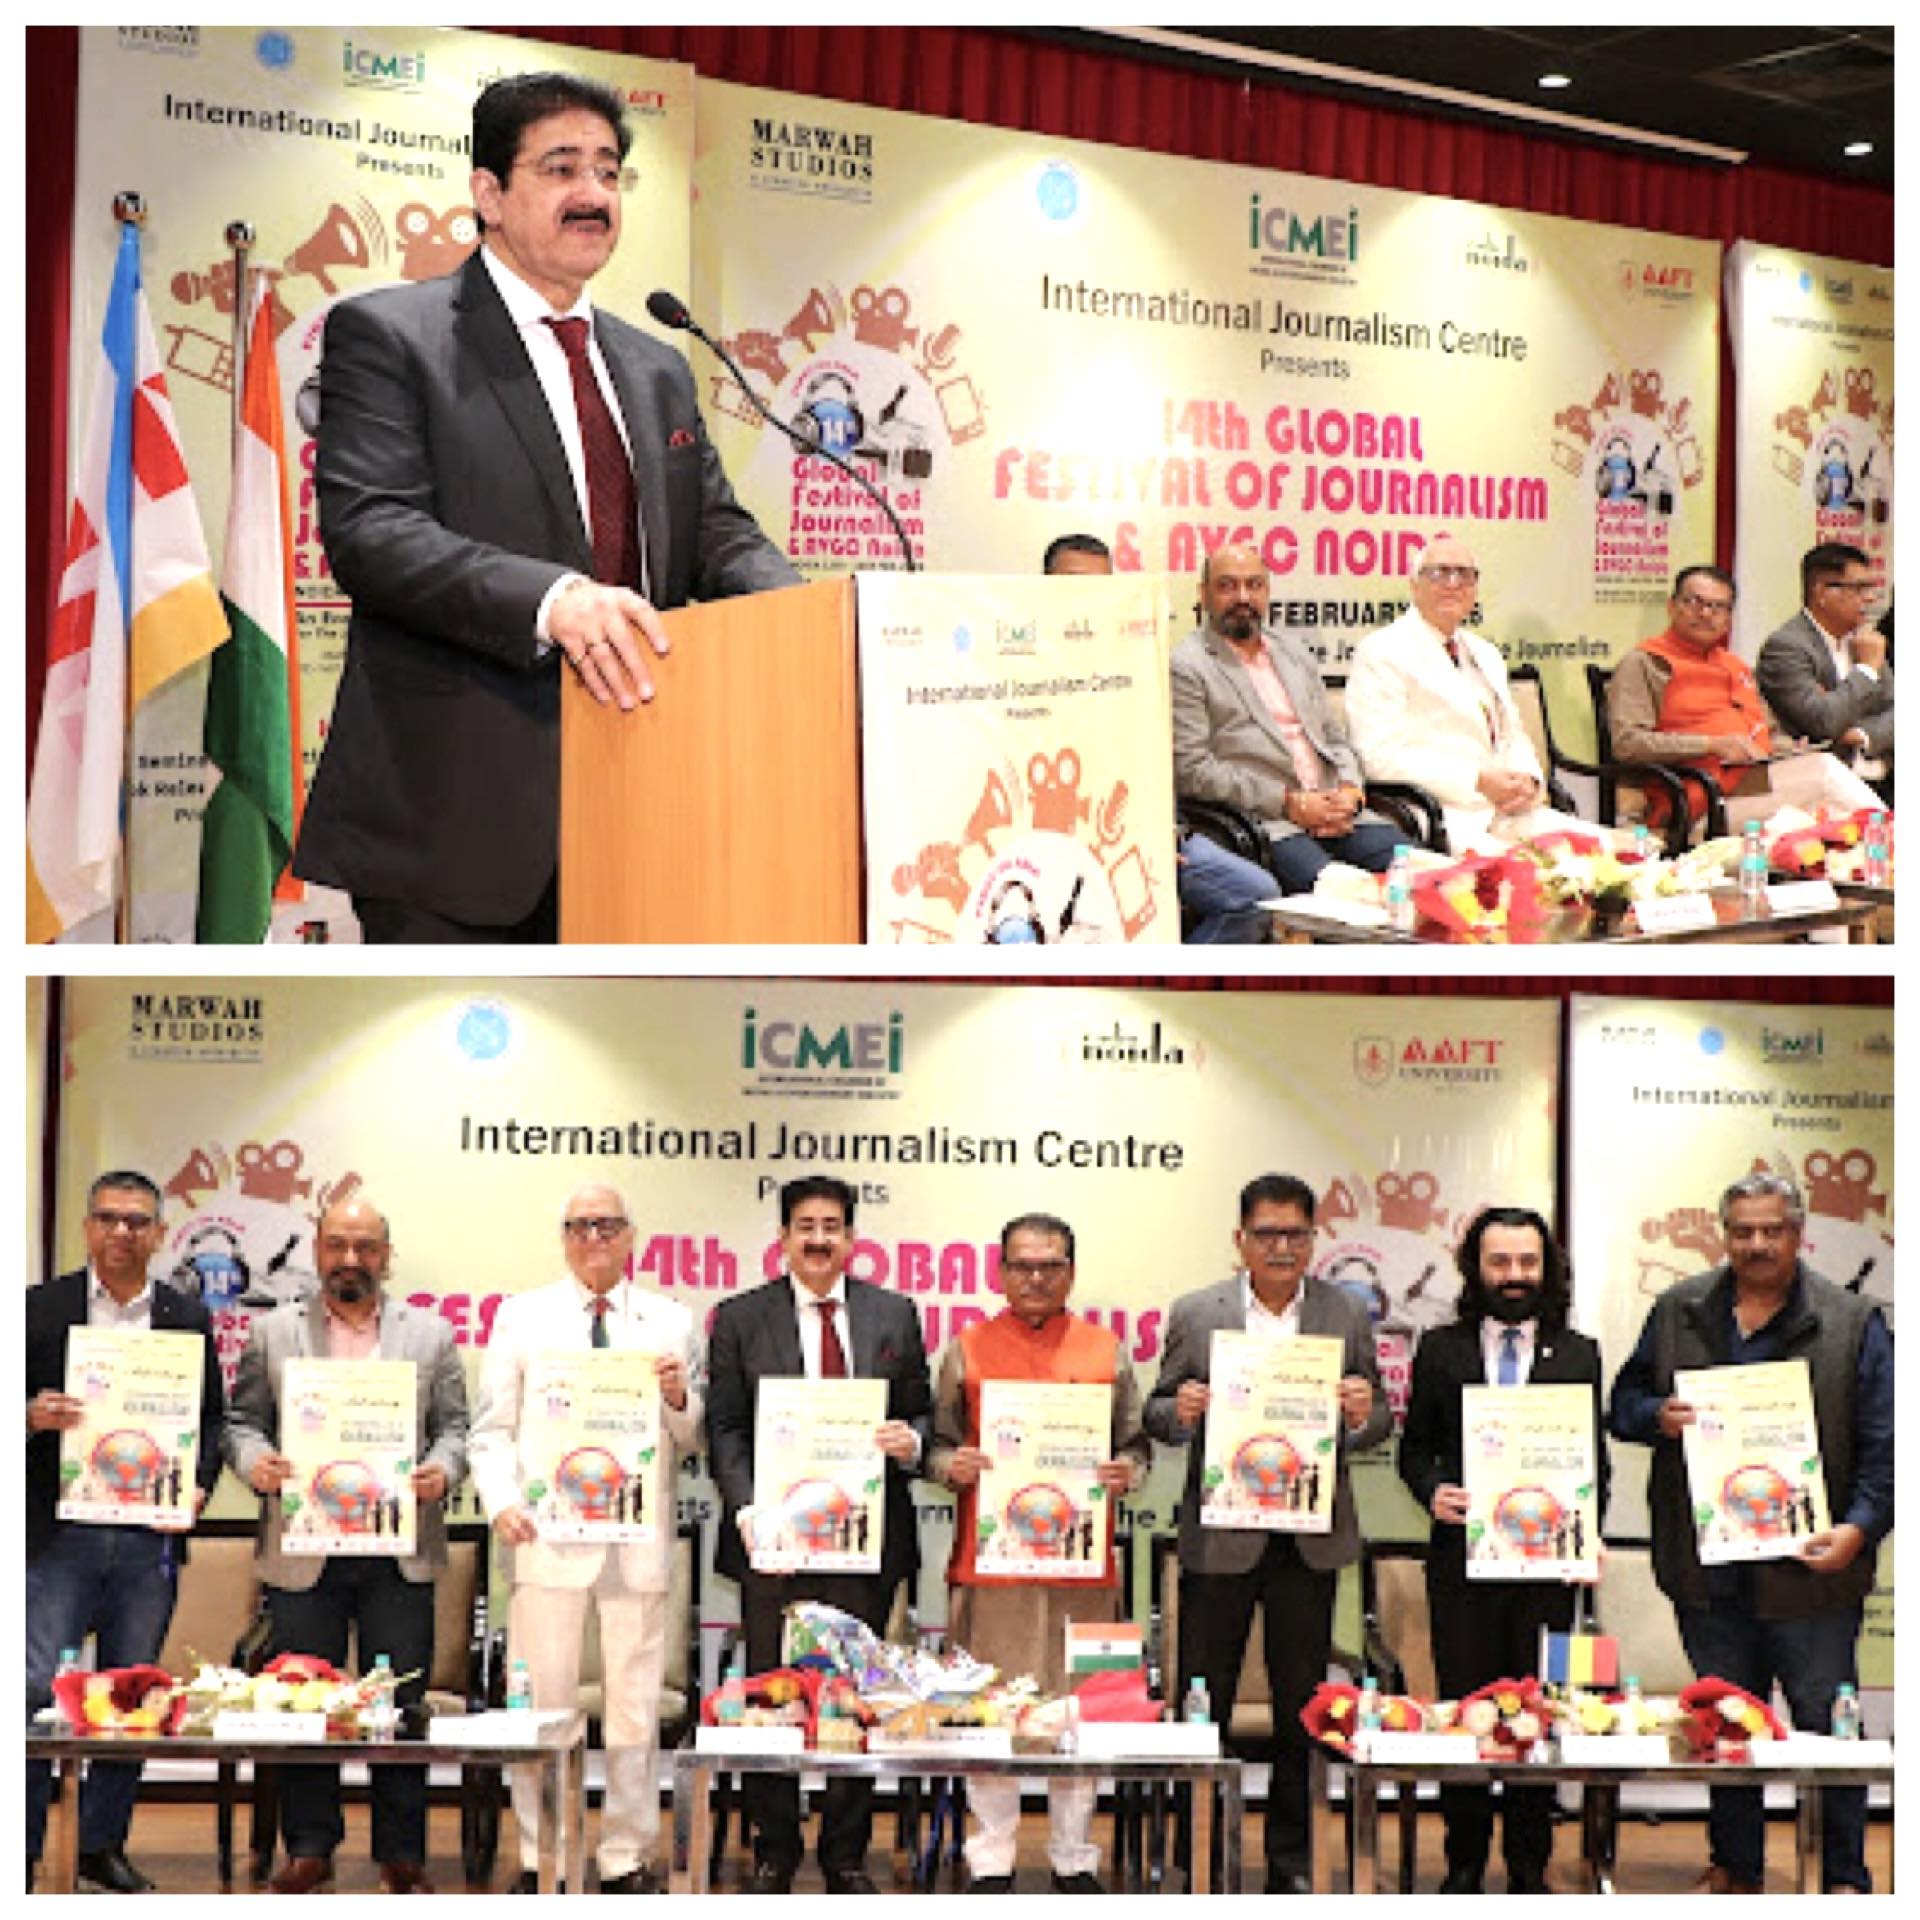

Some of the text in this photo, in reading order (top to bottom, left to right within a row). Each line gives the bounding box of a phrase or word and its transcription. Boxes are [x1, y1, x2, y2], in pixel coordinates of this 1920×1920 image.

[164, 94, 470, 156] International Journal
[751, 119, 873, 158] MARWAH
[356, 152, 445, 180] Presents
[751, 149, 873, 182] STUDIOS
[1249, 193, 1359, 263] iCMEi
[1042, 272, 1528, 363] International Journalism Centre
[1261, 347, 1352, 382] Presents
[1265, 403, 1424, 463] GLOBAL
[791, 456, 878, 482] Global
[791, 485, 888, 507] Festival
[1225, 460, 1291, 511] OF
[1301, 464, 1549, 520] JOURNALISM
[789, 509, 924, 535] Journalism
[1113, 520, 1144, 573] &
[1313, 526, 1452, 576] NOID
[130, 994, 264, 1020] MARWAH
[130, 1021, 264, 1043] STUDIOS
[742, 1005, 904, 1074] iCMEi
[1401, 1035, 1505, 1065] AAFT
[1399, 1066, 1505, 1084] UNIVERSITY
[1632, 1086, 1773, 1108] International
[460, 1115, 1185, 1171] International Journalism Centre
